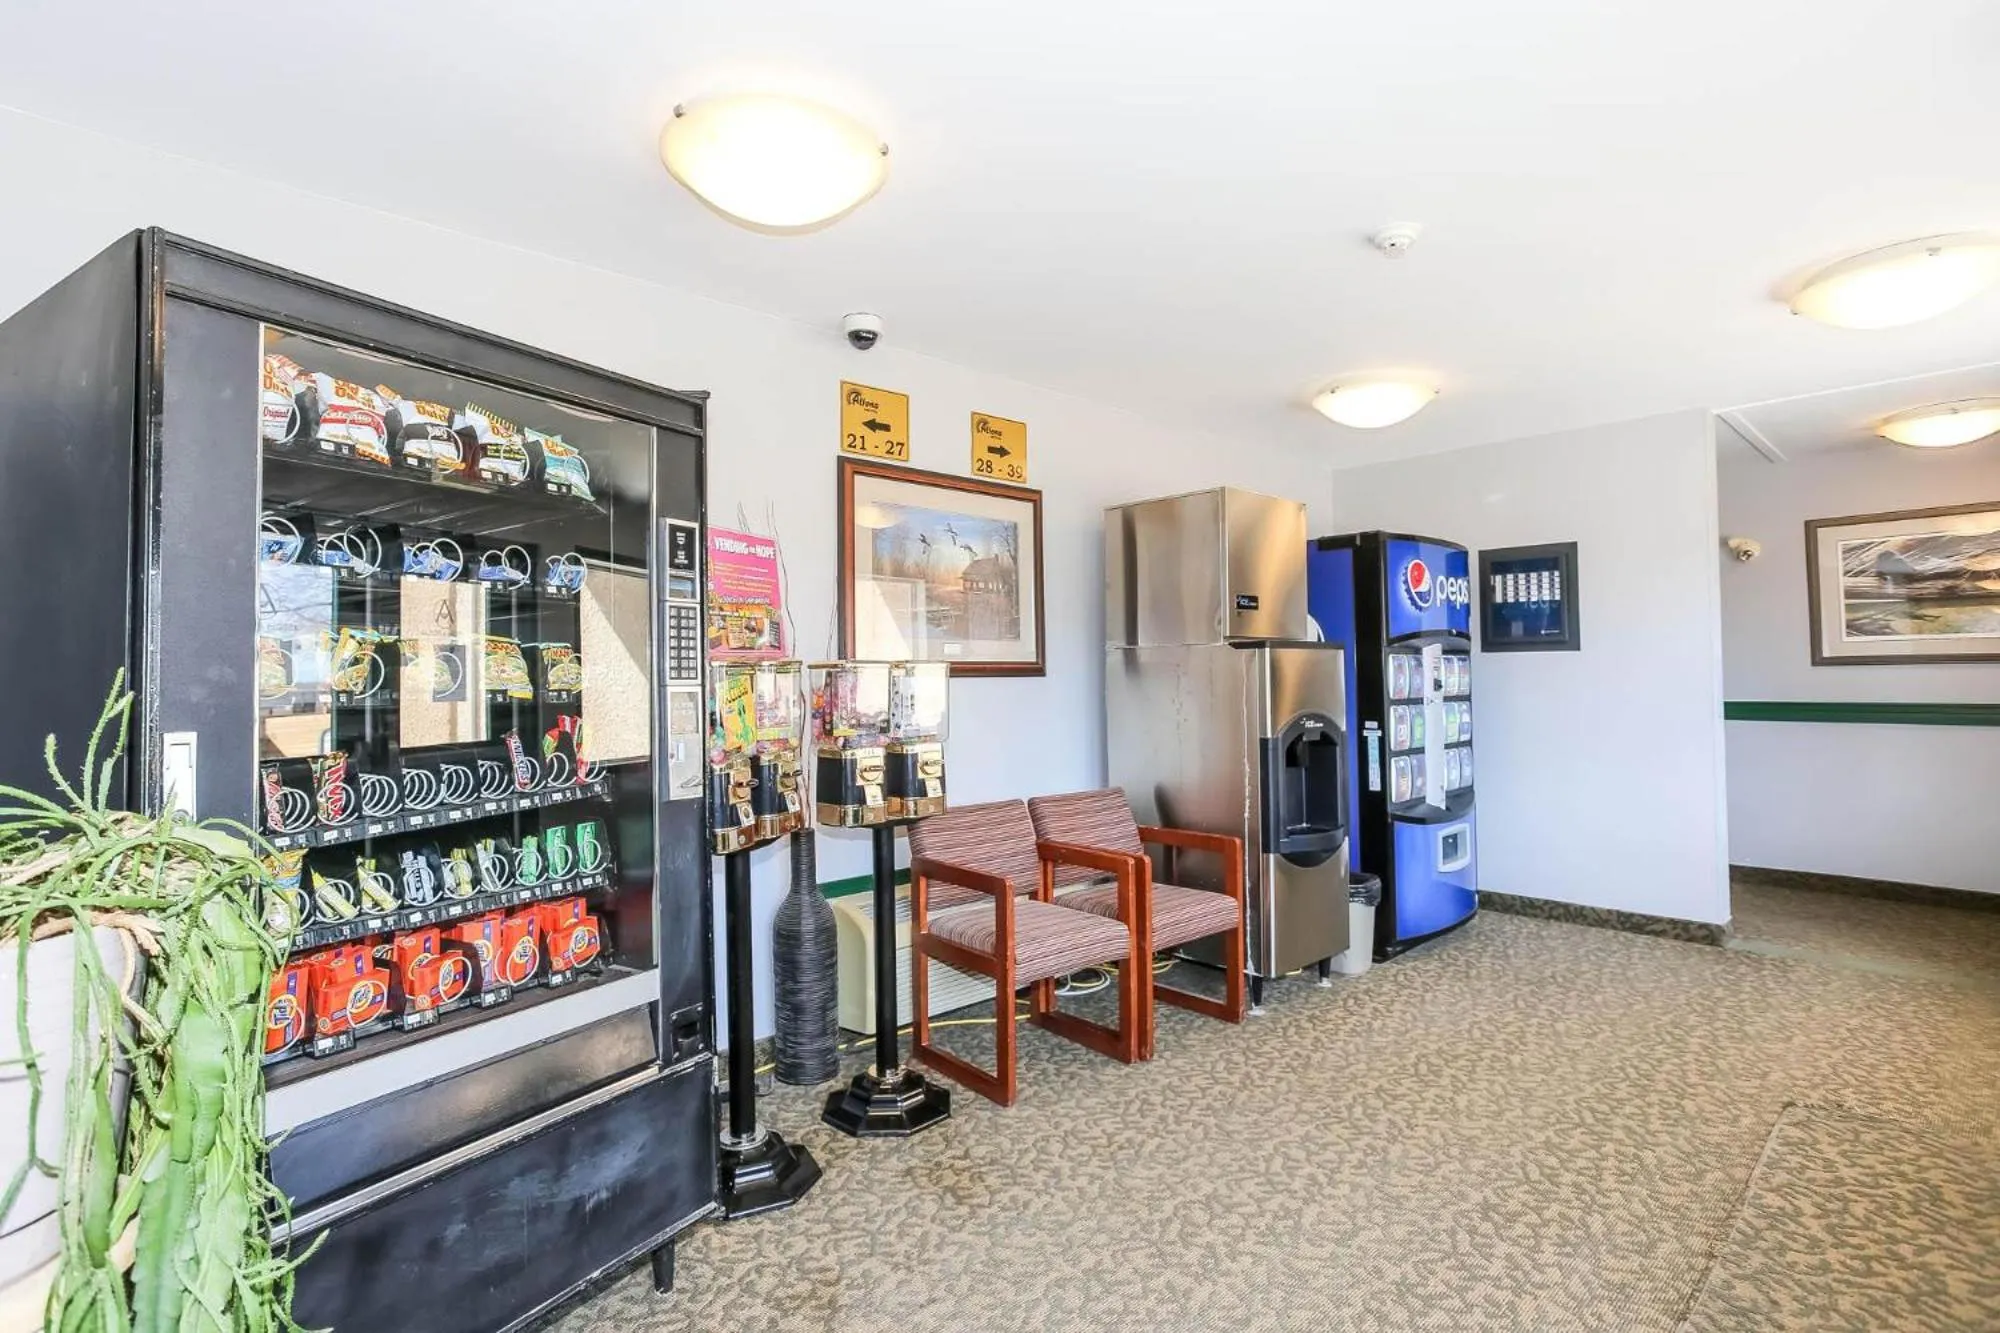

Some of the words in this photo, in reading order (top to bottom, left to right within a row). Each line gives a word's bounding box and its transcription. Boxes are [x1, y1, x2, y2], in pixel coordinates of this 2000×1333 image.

[846, 433, 866, 451] 21
[885, 440, 905, 457] 27
[976, 458, 993, 474] 28
[1007, 463, 1023, 479] 39
[511, 734, 531, 784] SNICKERS
[323, 763, 347, 822] TWIX
[351, 982, 372, 1010] Tide
